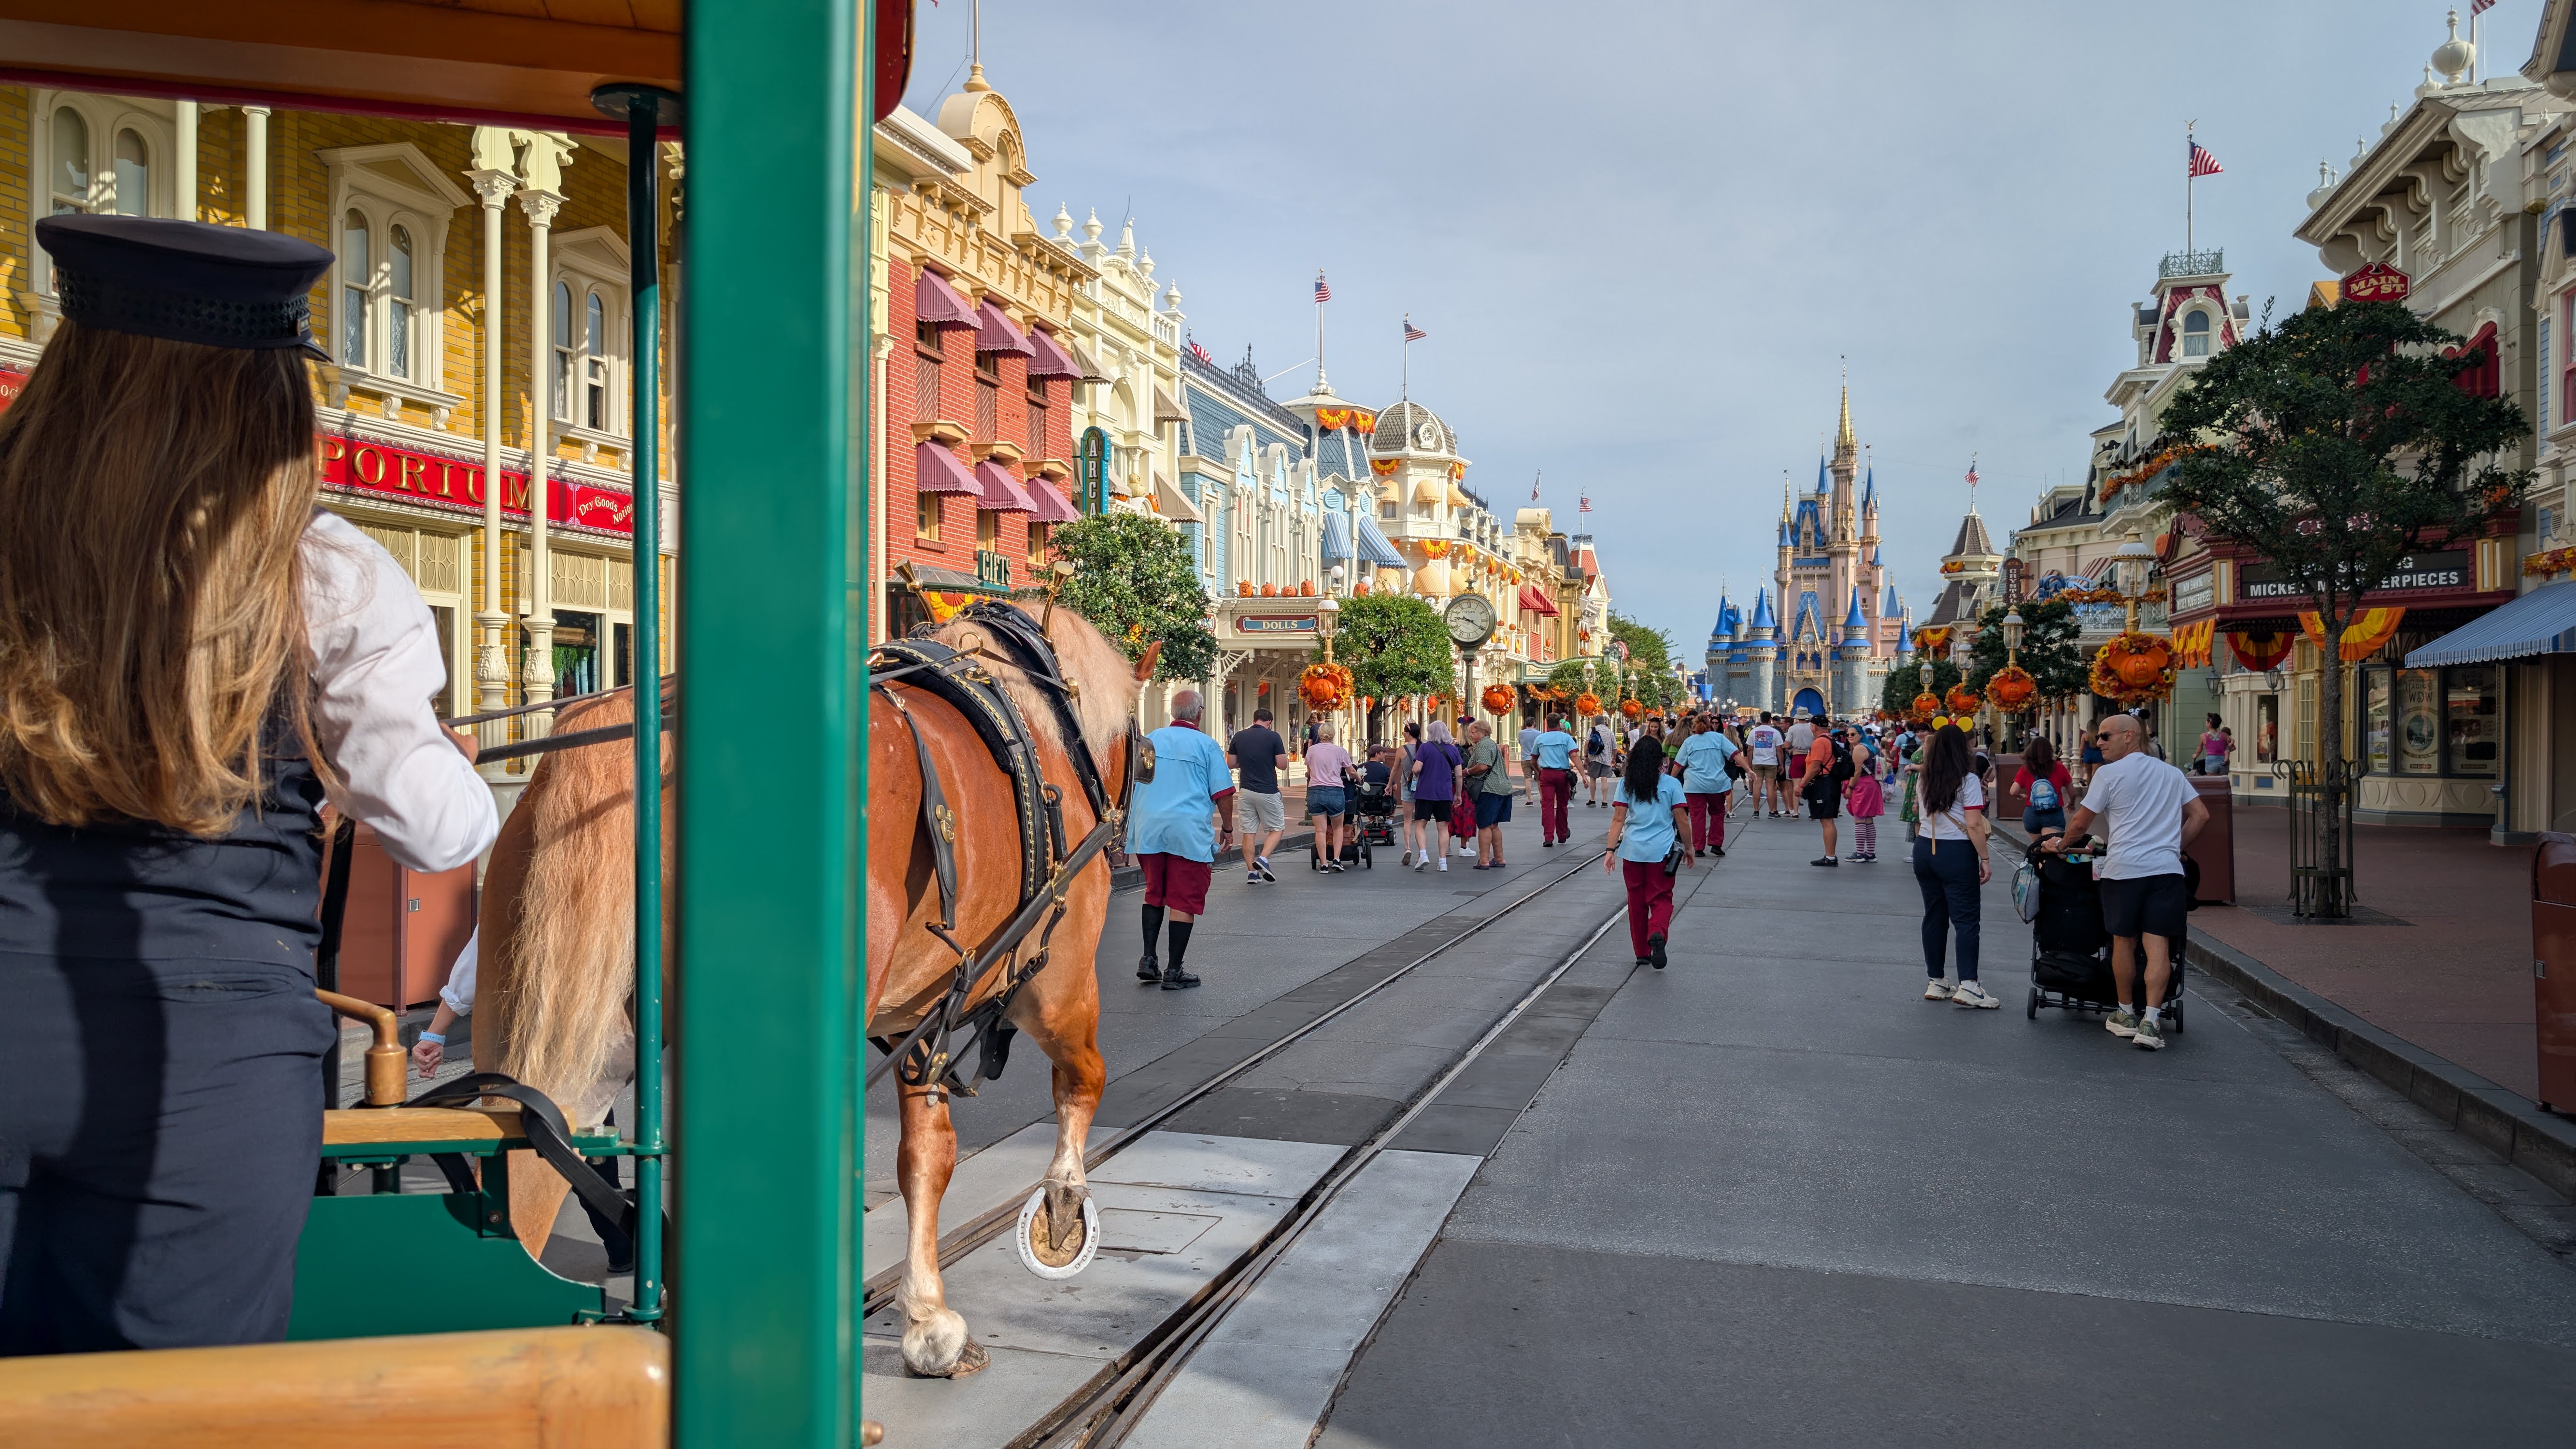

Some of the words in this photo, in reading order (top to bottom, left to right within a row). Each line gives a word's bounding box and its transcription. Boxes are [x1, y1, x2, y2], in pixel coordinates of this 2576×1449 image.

[2349, 276, 2401, 294] MAIN
[2380, 284, 2405, 294] ST.
[579, 499, 593, 516] Dry
[595, 496, 618, 512] Goods
[982, 551, 1012, 584] GIFTS
[2008, 568, 2017, 603] CRYSTAL
[1262, 621, 1298, 629] DOLLS
